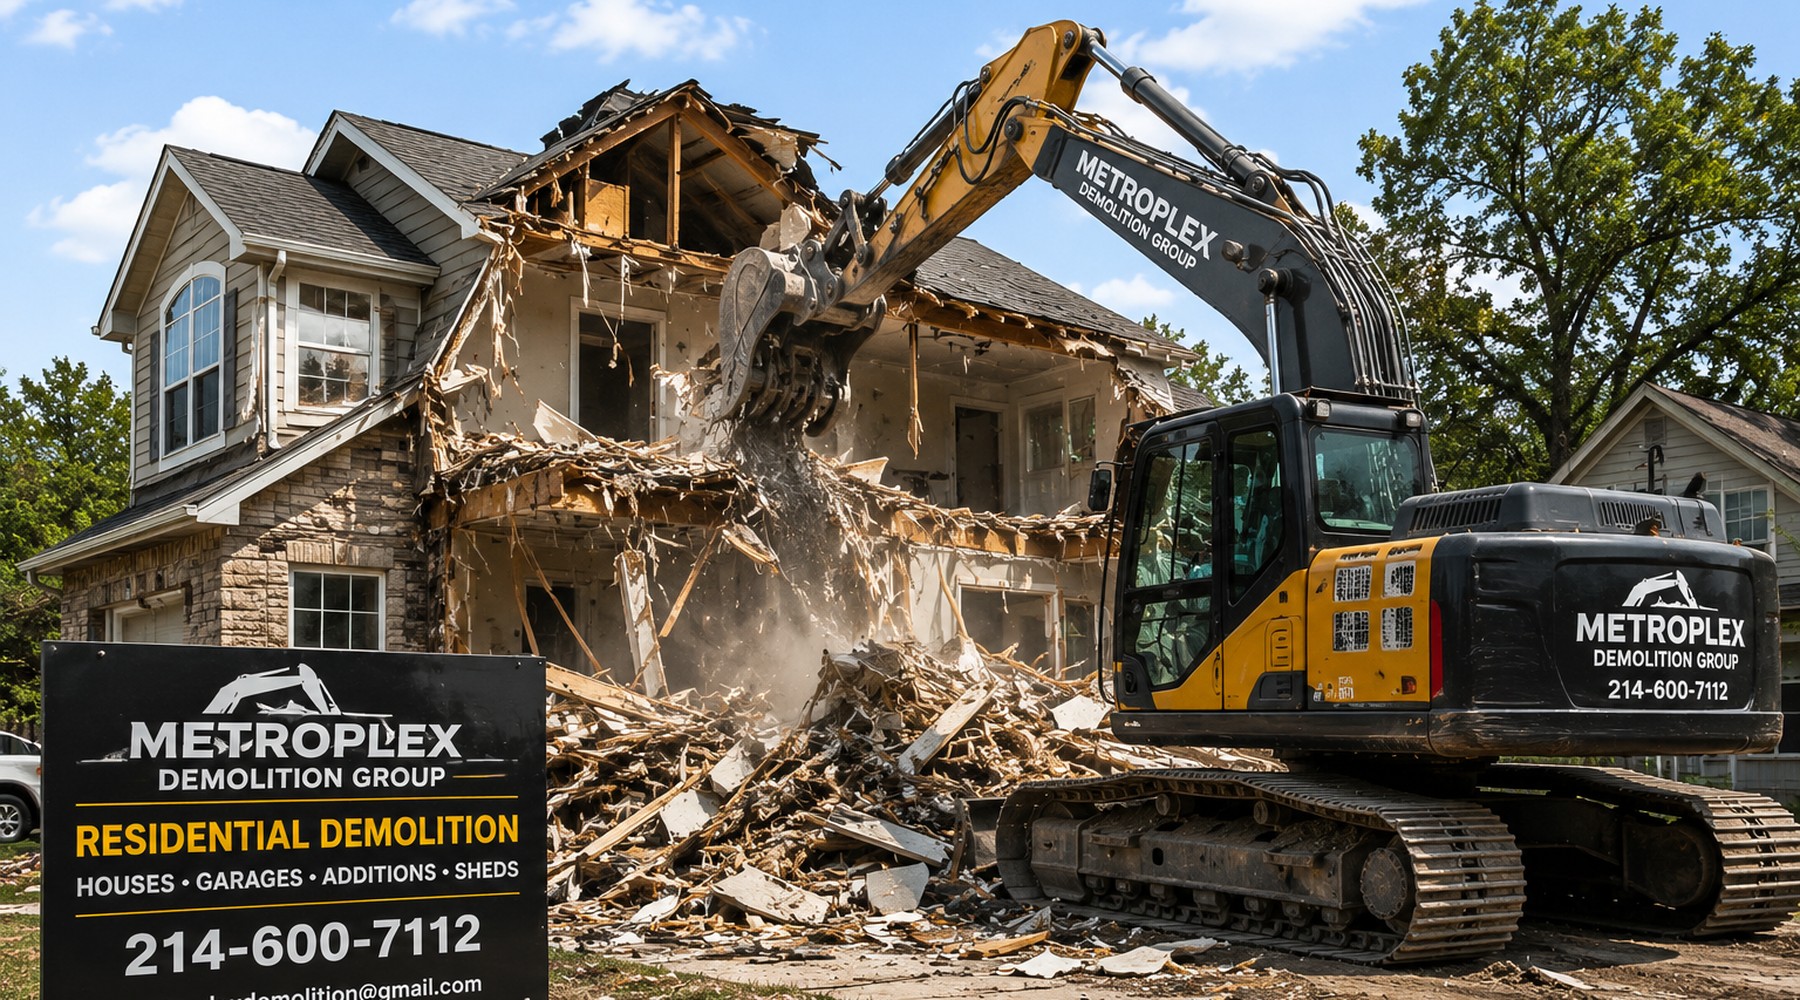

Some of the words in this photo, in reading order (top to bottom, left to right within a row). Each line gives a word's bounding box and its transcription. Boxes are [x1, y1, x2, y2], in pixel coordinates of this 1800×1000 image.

[1075, 149, 1219, 261] METROPLEX
[1078, 181, 1151, 241] DEMOLITION
[1151, 232, 1198, 270] GROUP
[1576, 612, 1746, 648] METROPLEX
[1593, 649, 1693, 668] DEMOLITION
[1696, 651, 1739, 670] GROUP
[1608, 679, 1729, 701] 214-600-7112
[129, 721, 462, 759] METROPLEX
[158, 767, 343, 791] DEMOLITION
[352, 766, 446, 788] GROUP
[76, 819, 310, 858] RESIDENTIAL
[320, 814, 519, 849] DEMOLITION
[77, 873, 175, 898] HOUSES
[196, 868, 303, 891] GARAGES
[321, 863, 437, 885] ADDITIONS
[454, 860, 519, 880] SHEDS
[124, 914, 481, 977] 214-600-7112
